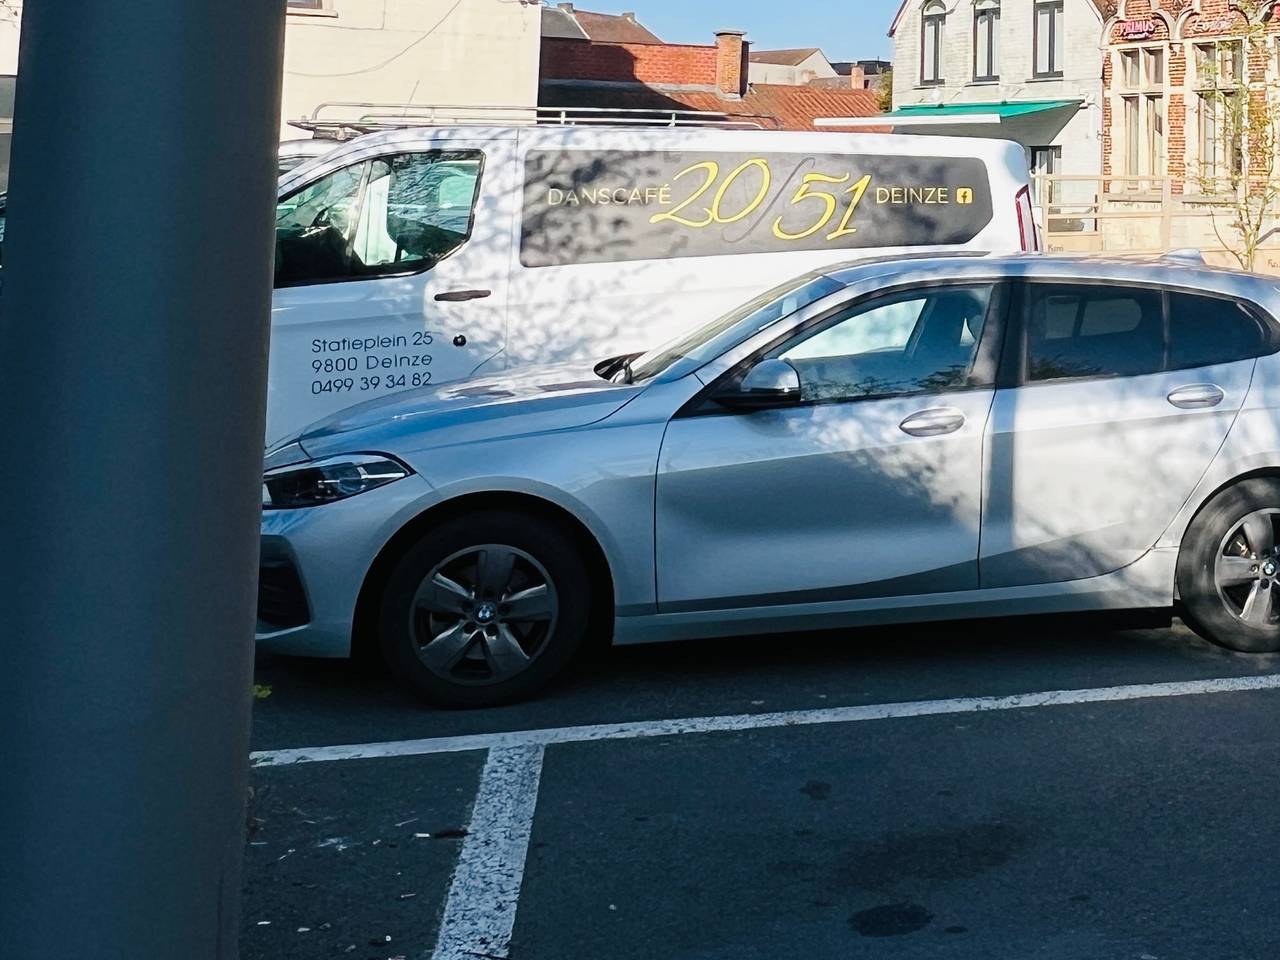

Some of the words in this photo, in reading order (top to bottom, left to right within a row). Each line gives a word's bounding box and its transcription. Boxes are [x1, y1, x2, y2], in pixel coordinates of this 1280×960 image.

[1119, 20, 1154, 35] PRIMUS
[547, 183, 672, 206] DANSCAFÉ
[875, 187, 949, 204] DEINZE
[311, 333, 407, 353] Statieplein
[411, 331, 434, 346] 25
[311, 357, 358, 374] 9800
[366, 353, 433, 370] Deinze
[311, 377, 354, 395] 0499
[360, 375, 380, 391] 39
[385, 374, 406, 389] 34
[411, 372, 432, 387] 82
